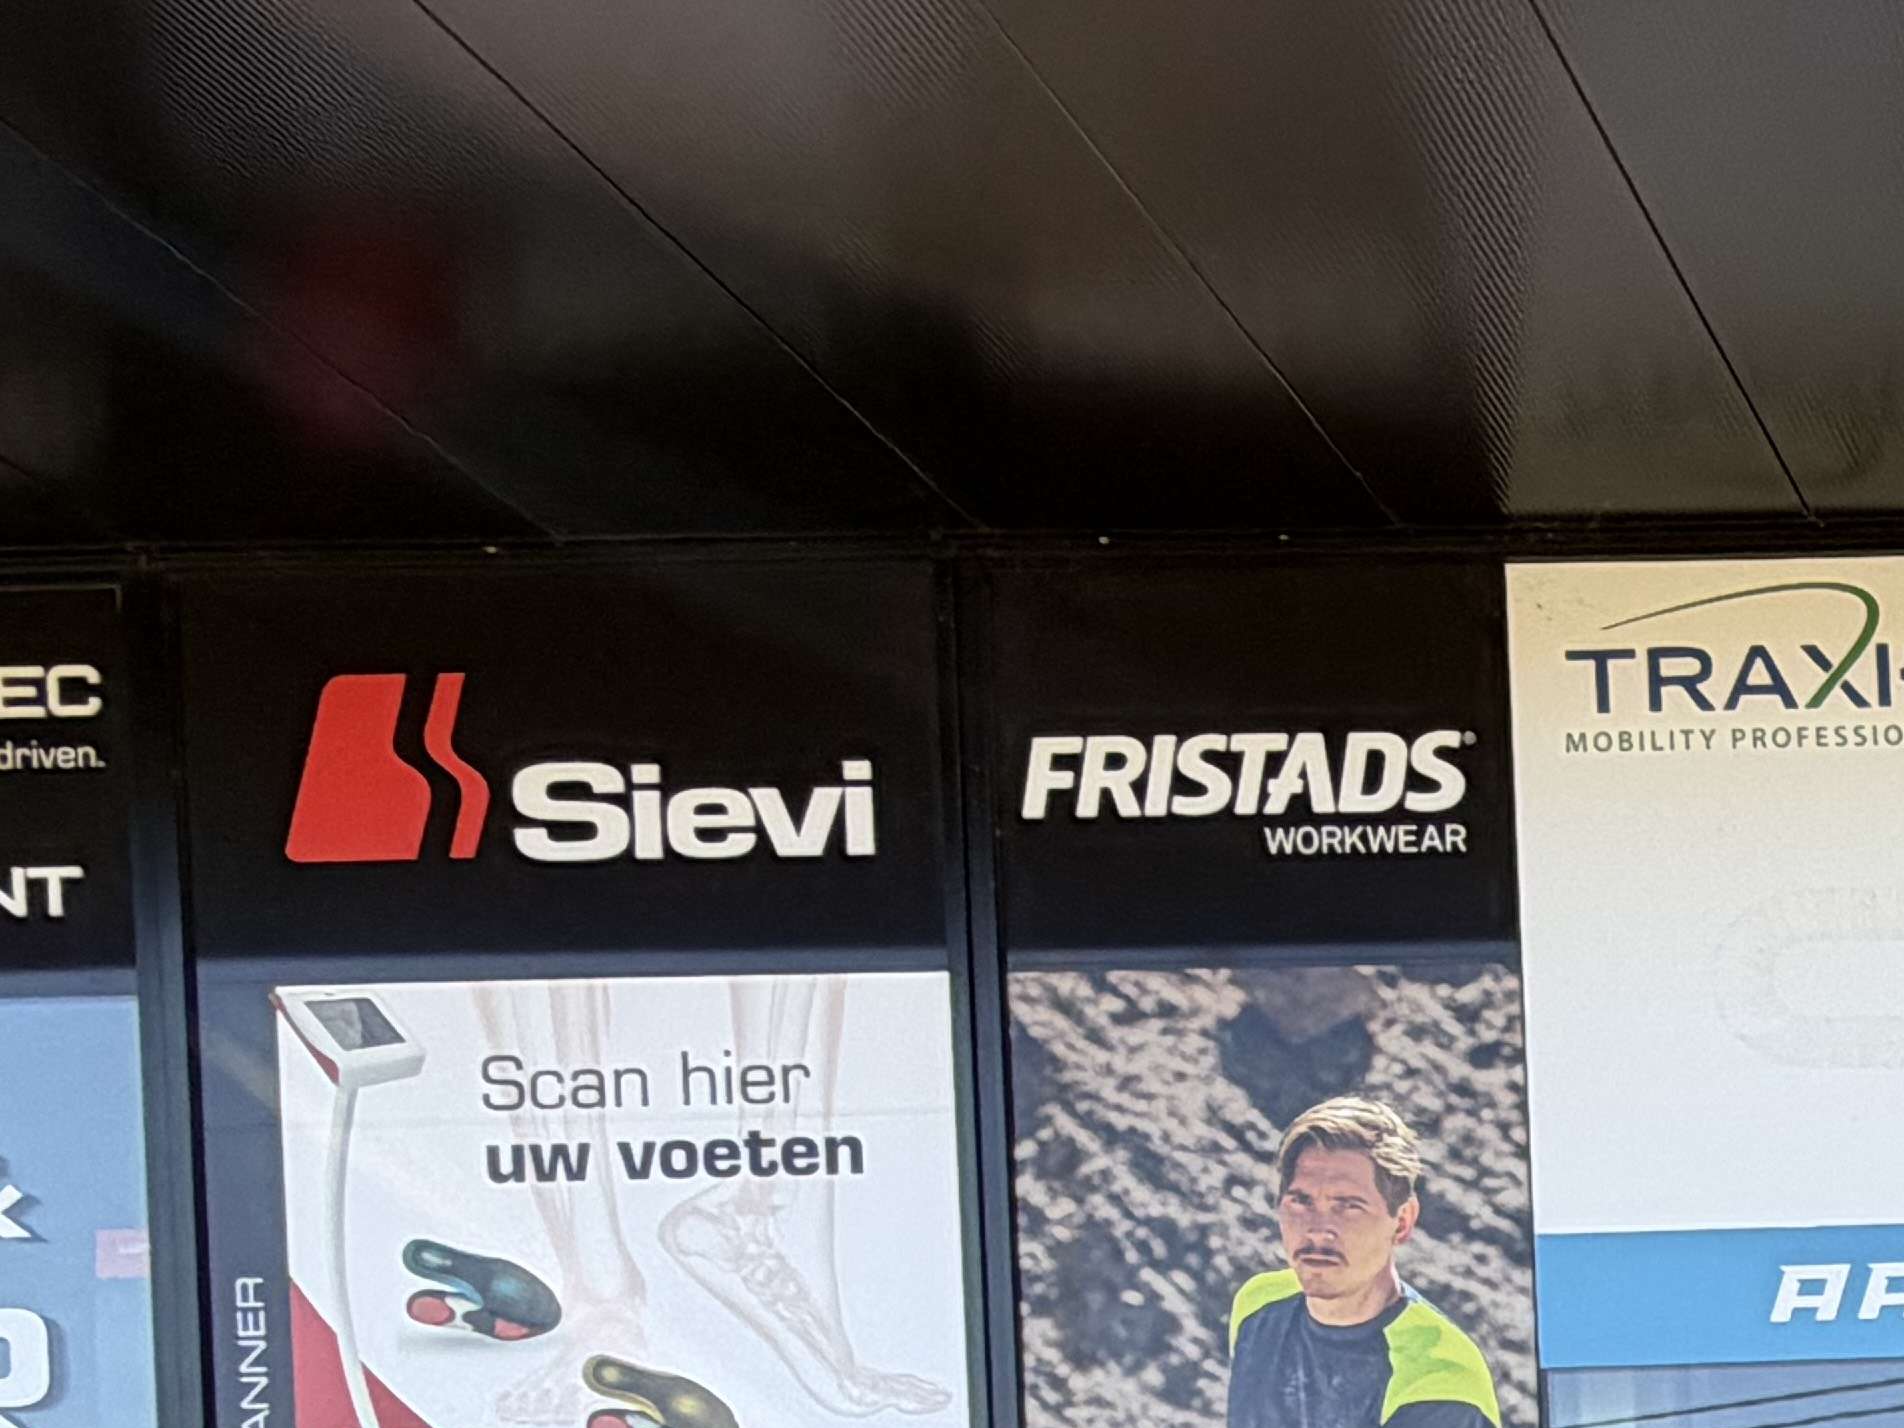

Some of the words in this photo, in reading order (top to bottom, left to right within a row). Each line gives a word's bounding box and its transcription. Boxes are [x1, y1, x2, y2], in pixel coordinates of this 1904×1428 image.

[0, 739, 106, 770] driven.
[1564, 726, 1717, 755] MOBILITY
[1020, 730, 1468, 820] FRISTADS
[510, 759, 877, 862] Sievi
[1263, 823, 1468, 856] WORKWEAR
[480, 1053, 649, 1113] Scan
[681, 1050, 812, 1107] hier
[486, 1141, 590, 1186] uw
[618, 1131, 865, 1182] voeten
